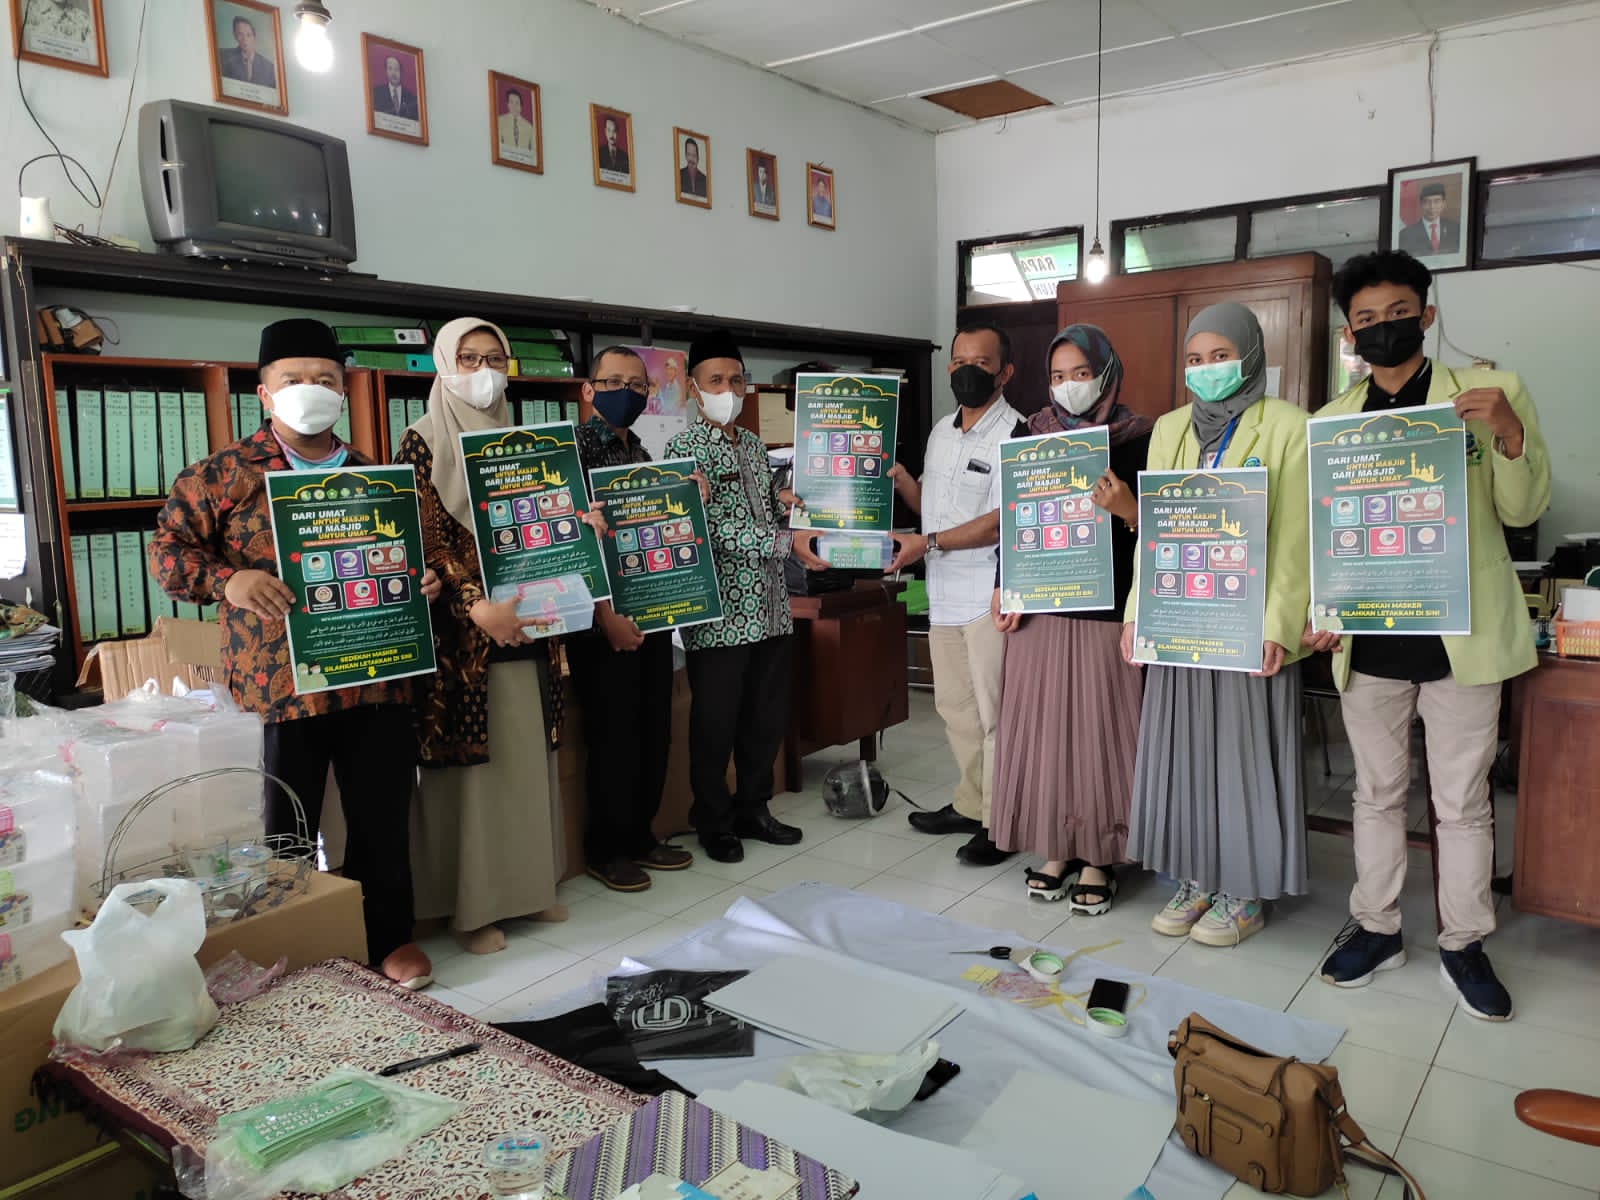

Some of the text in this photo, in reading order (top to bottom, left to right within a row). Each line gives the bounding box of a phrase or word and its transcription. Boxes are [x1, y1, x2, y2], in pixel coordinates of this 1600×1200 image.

[1327, 453, 1381, 466] DARI UMAT
[1346, 459, 1406, 471] UNTUK MASJID
[480, 463, 520, 474] DARI UMAT
[495, 467, 539, 478] UNTUK MASJID
[1332, 467, 1395, 480] DARI MASJID
[485, 474, 533, 486] DARI MASJID
[1034, 478, 1061, 487] MASJID
[1379, 474, 1402, 482] UMAT
[522, 480, 538, 488] UMAT
[608, 495, 646, 506] DARI UMAT
[292, 509, 347, 521] DARI UMAT
[631, 506, 657, 514] MASJID
[1174, 506, 1197, 514] UMAT
[313, 515, 370, 525] UNTUK MASJID
[1157, 520, 1209, 528] DARI MASJID
[299, 523, 361, 535] DARI MASJID
[1377, 609, 1414, 617] LETAKKAN
[340, 648, 398, 663] SEDEKAH MASKER
[324, 662, 359, 673] SILAHKAN
[360, 657, 392, 668] LETAKKAN
[401, 653, 412, 662] SINI
